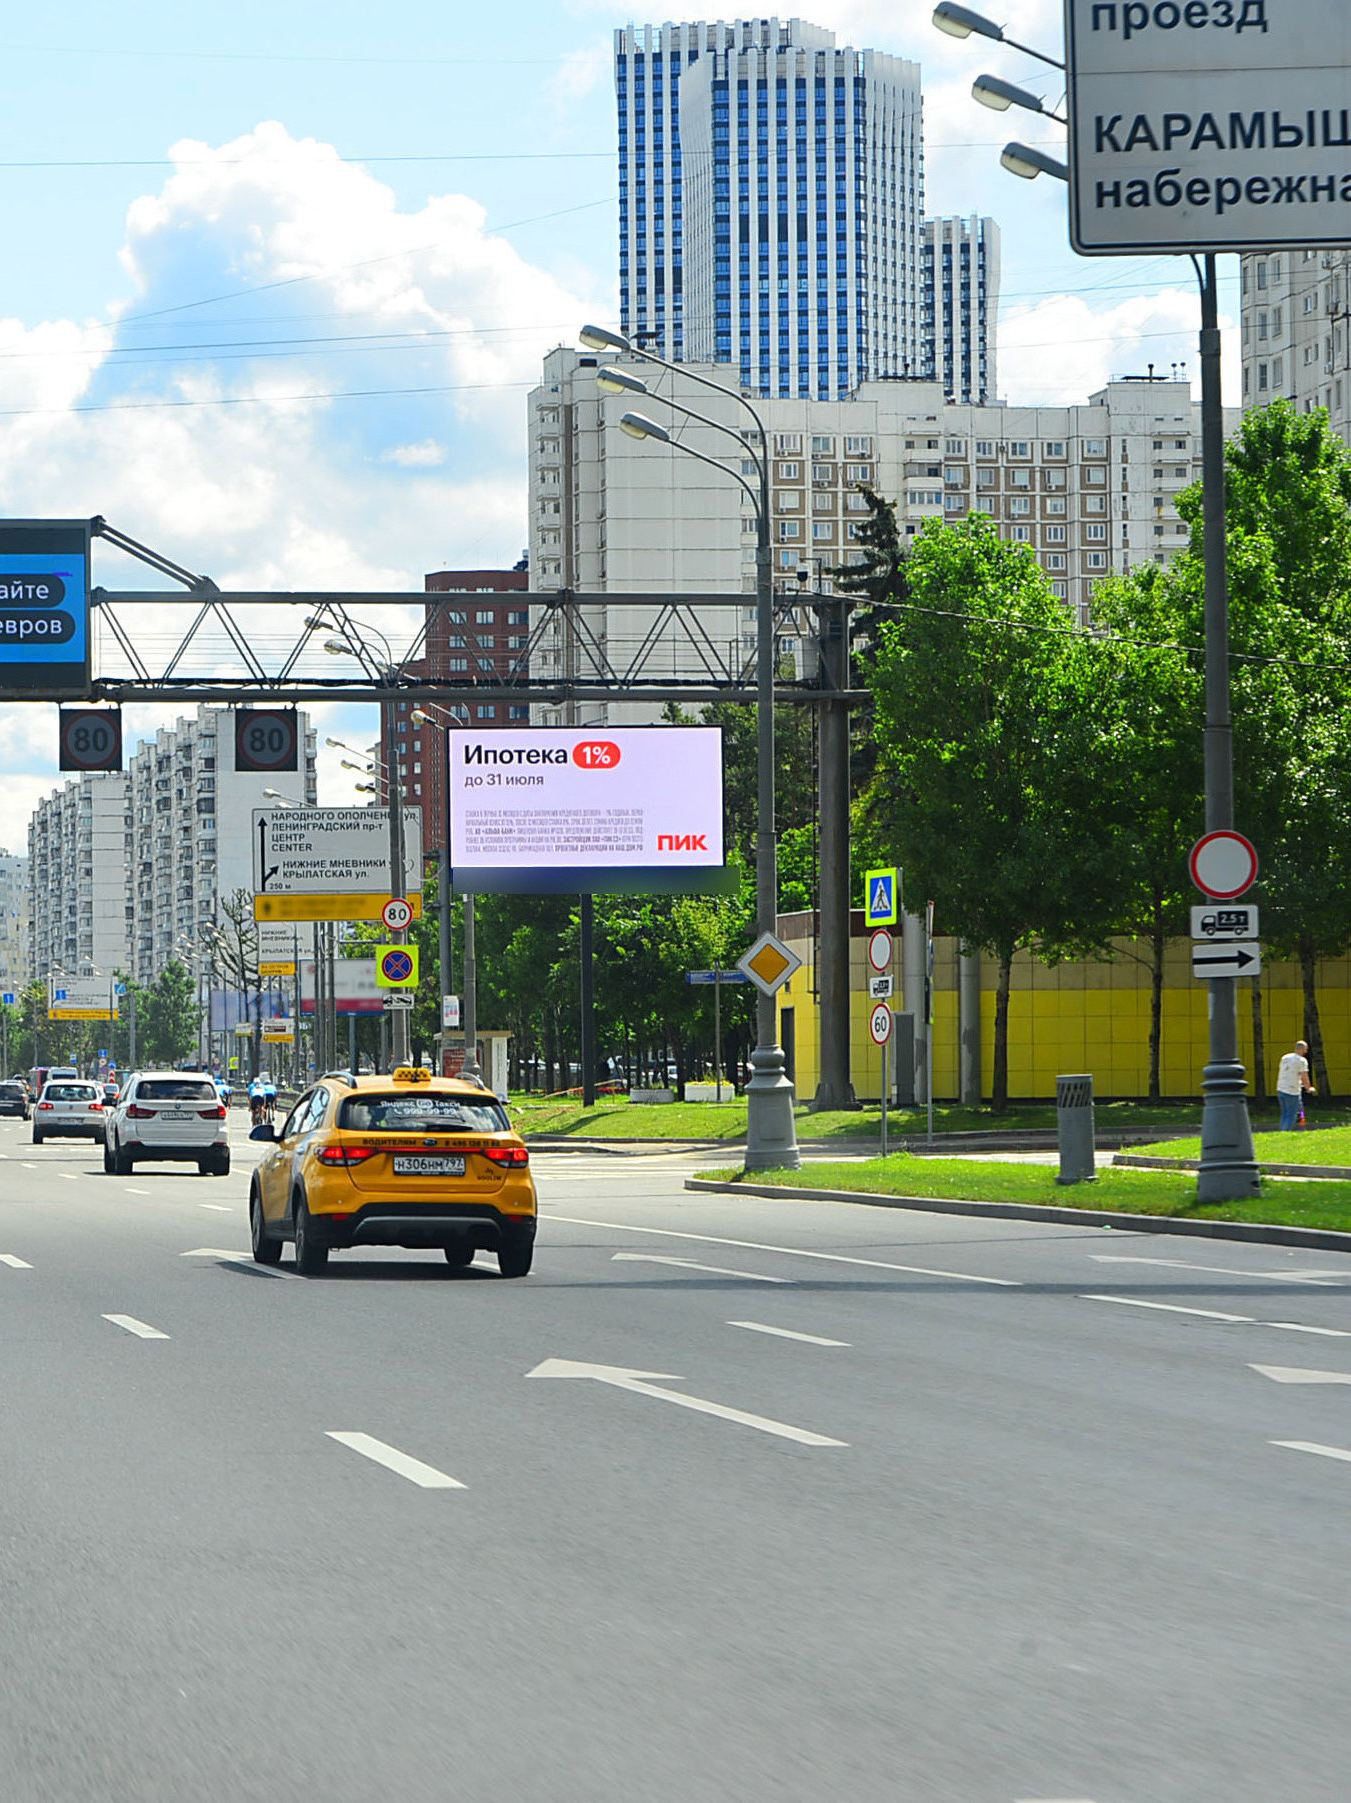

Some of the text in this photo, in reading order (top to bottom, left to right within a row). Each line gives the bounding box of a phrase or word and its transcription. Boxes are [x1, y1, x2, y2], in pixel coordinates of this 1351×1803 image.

[1092, 0, 1268, 40] проезд
[1095, 109, 1351, 153] КАРАМЫШ
[74, 727, 108, 752] 80
[250, 727, 284, 752] 80
[464, 745, 610, 765] Ипотека 1%
[464, 774, 544, 787] до 31 июля
[271, 811, 335, 821] НАРОДНОГО
[337, 811, 390, 820] ОПОЛЧЕН
[271, 822, 383, 832] ЛЕНИНГРАДСКИЙ пр-т
[271, 833, 306, 843] ЦЕНТР
[658, 834, 709, 851] ПИК
[271, 843, 312, 852] CENTER
[282, 860, 327, 868] НИЖНИЕ
[329, 859, 386, 868] МНЕВНИКИ
[282, 869, 353, 879] КРЫЛАТСКАЯ
[388, 908, 407, 920] 80
[875, 1016, 887, 1032] 60
[397, 1158, 444, 1170] Н306НМ
